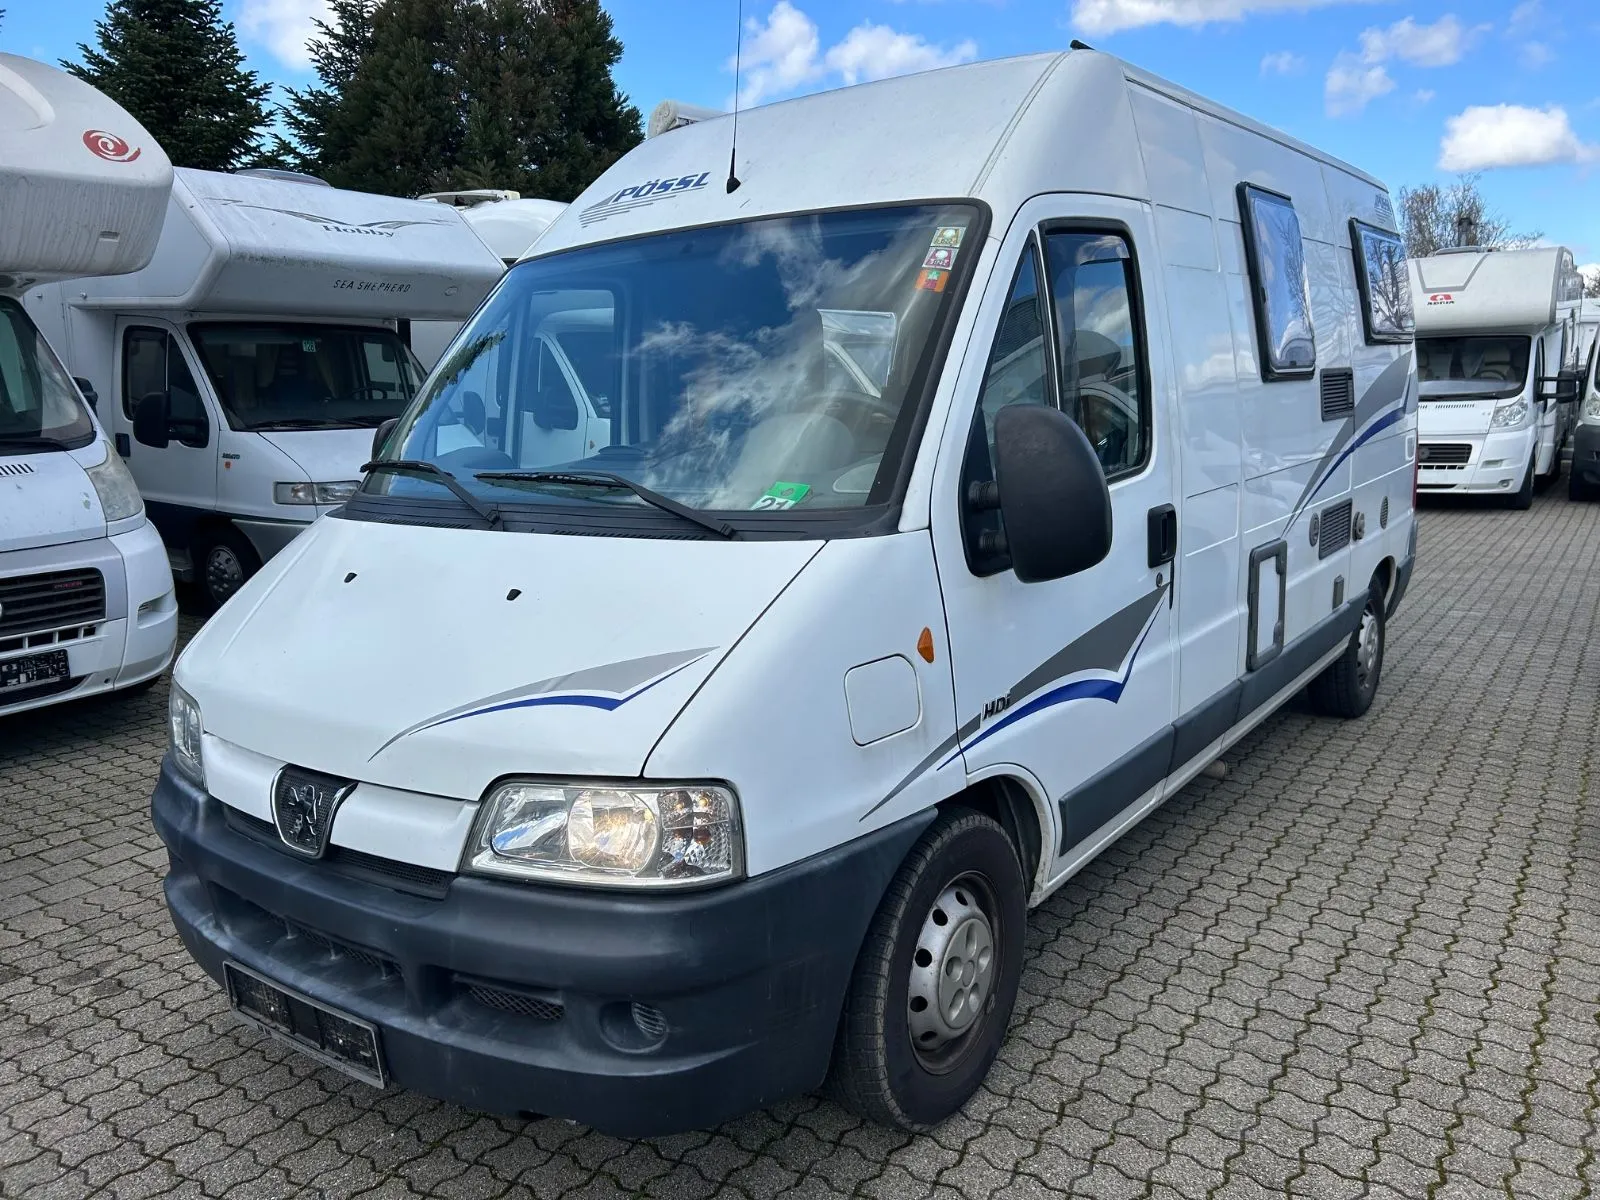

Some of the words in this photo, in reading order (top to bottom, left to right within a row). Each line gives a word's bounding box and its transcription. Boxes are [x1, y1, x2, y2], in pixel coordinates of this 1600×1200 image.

[612, 171, 711, 203] PÖSSL
[322, 225, 394, 238] Hobby
[333, 279, 355, 290] SEA
[357, 281, 412, 293] SHEPHERD
